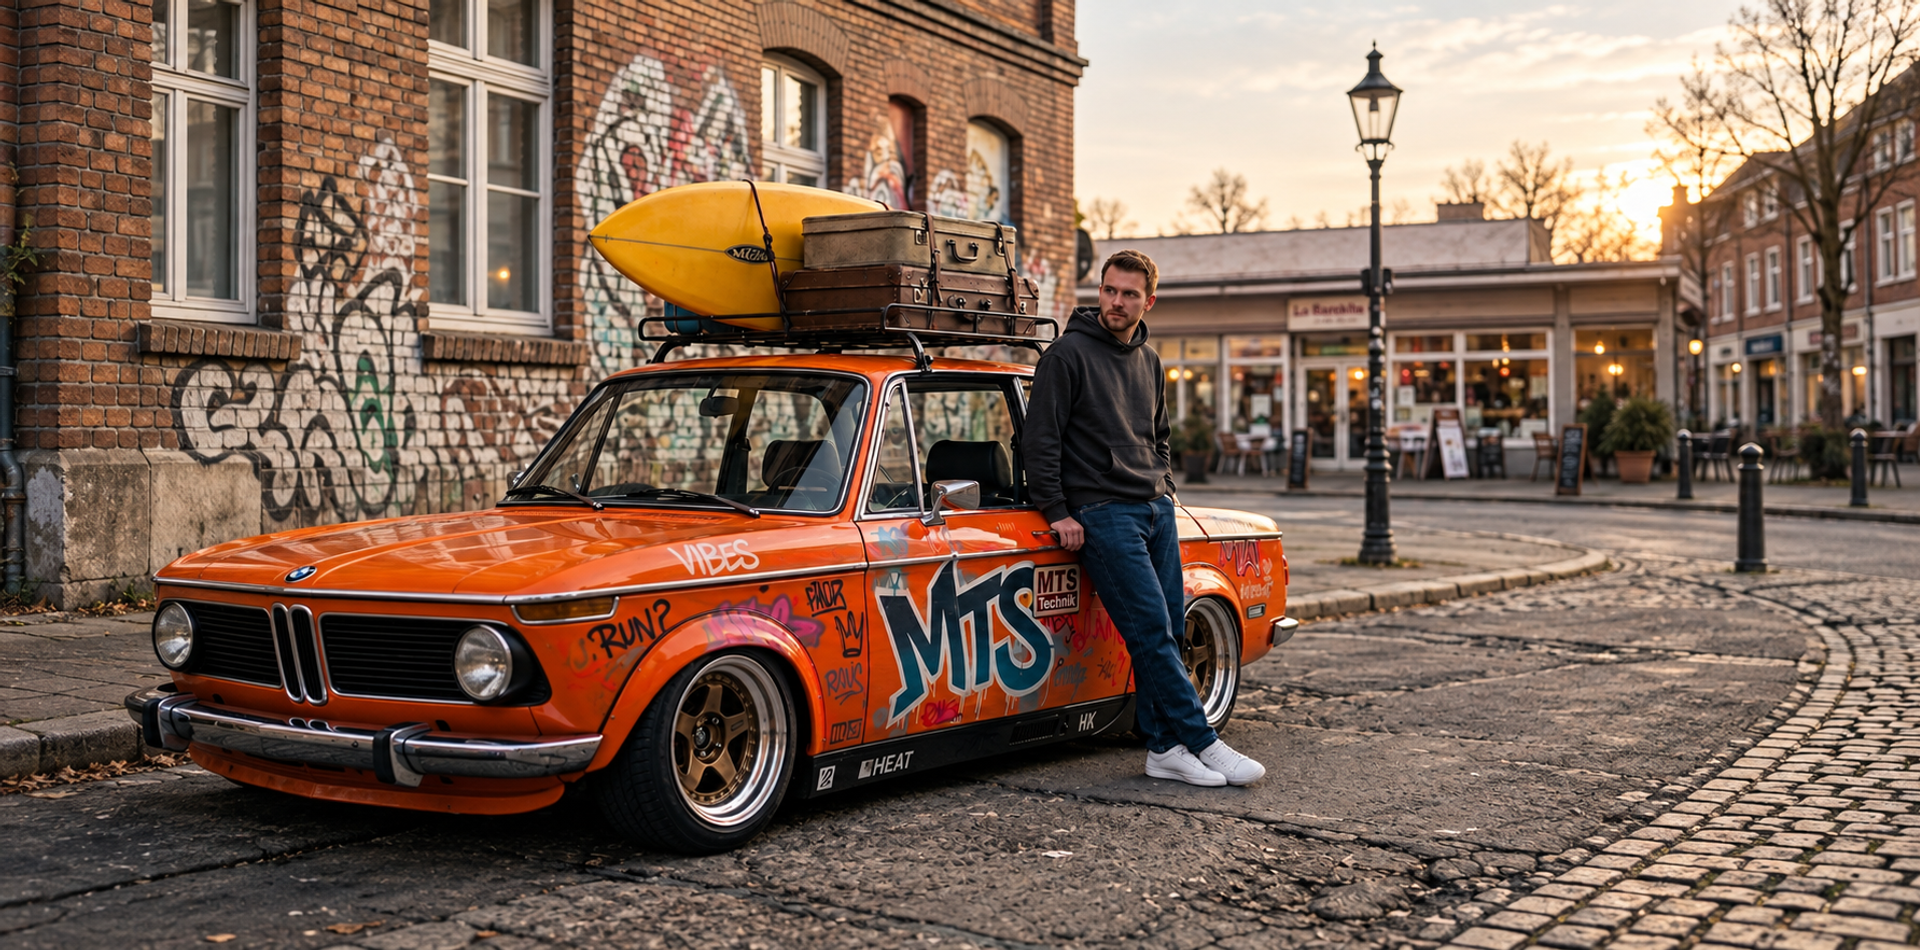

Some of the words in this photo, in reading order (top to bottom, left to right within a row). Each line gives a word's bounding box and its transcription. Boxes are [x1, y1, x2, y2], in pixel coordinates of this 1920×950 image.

[667, 538, 760, 576] VIBES
[1037, 568, 1077, 594] MTS
[1038, 593, 1076, 610] Technik
[875, 560, 1055, 729] MTS
[1078, 711, 1097, 732] HK
[872, 750, 915, 776] HEAT
